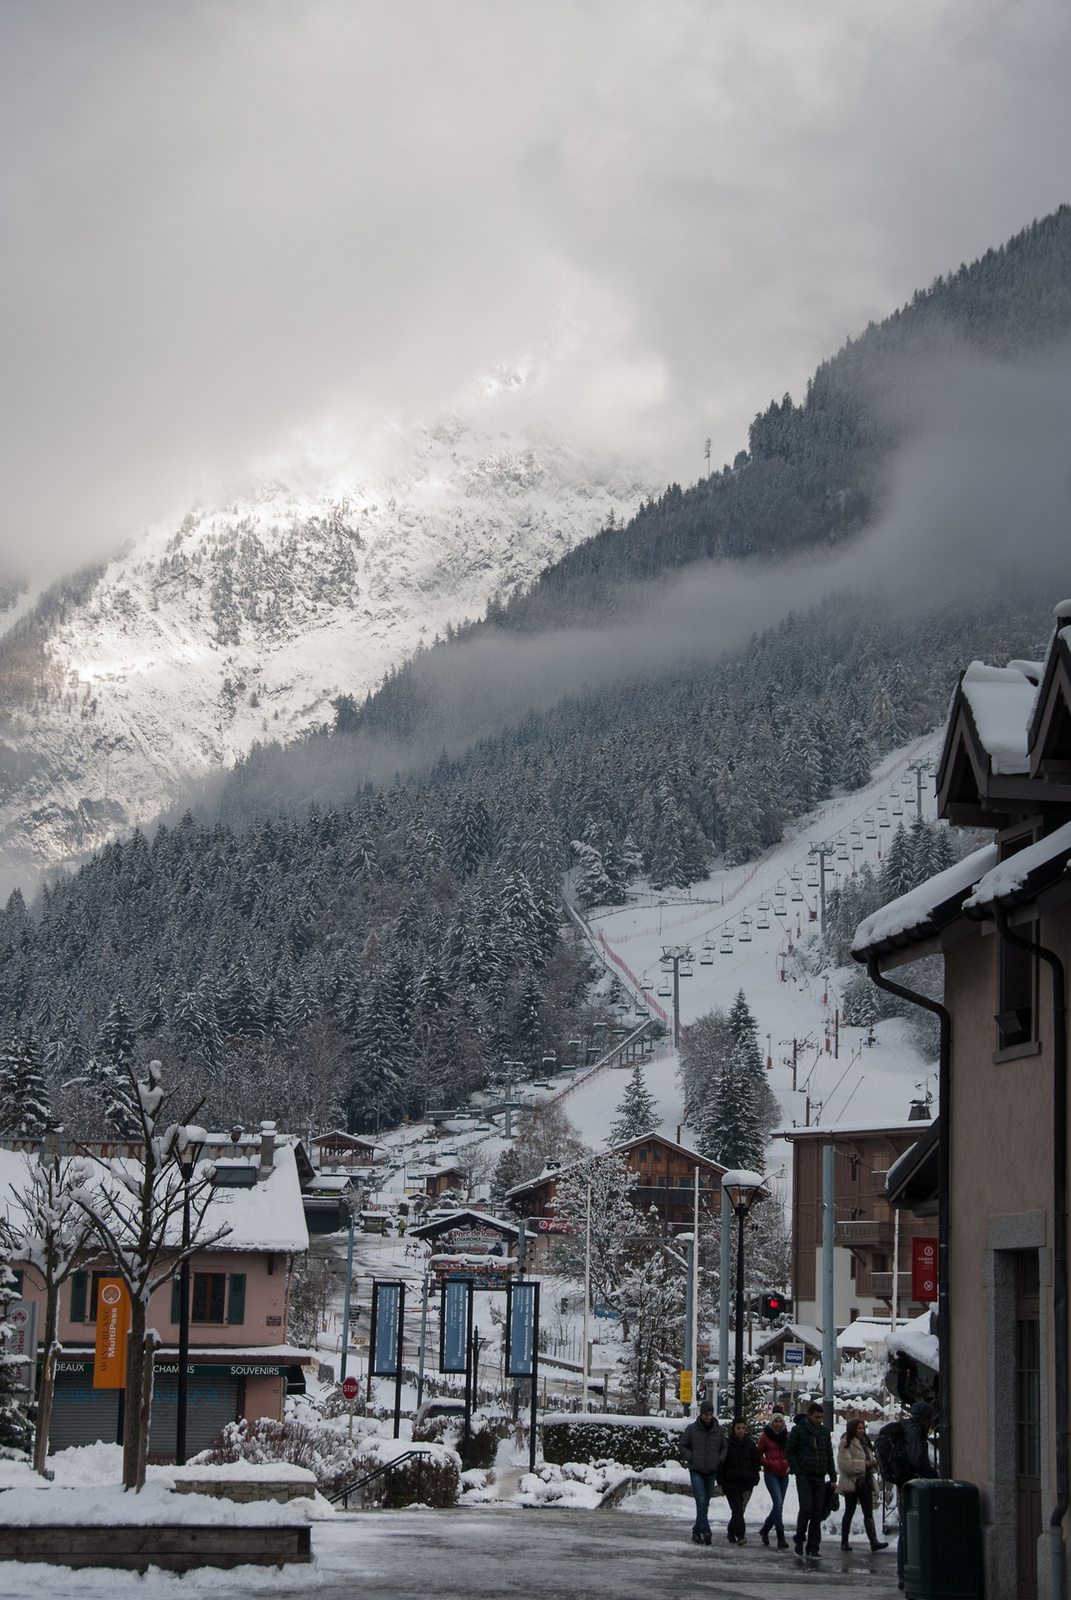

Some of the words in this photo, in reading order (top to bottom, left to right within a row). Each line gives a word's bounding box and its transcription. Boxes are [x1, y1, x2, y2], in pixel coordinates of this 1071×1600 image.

[454, 1230, 470, 1238] Parc
[471, 1229, 481, 1238] de
[102, 1308, 110, 1340] BLANC
[108, 1308, 117, 1357] MultiPass
[100, 1345, 108, 1372] MONT
[41, 1363, 85, 1372] DEAUX
[153, 1364, 195, 1374] CHAMIS
[231, 1366, 280, 1376] SOUVENIRS
[344, 1384, 358, 1393] STOP
